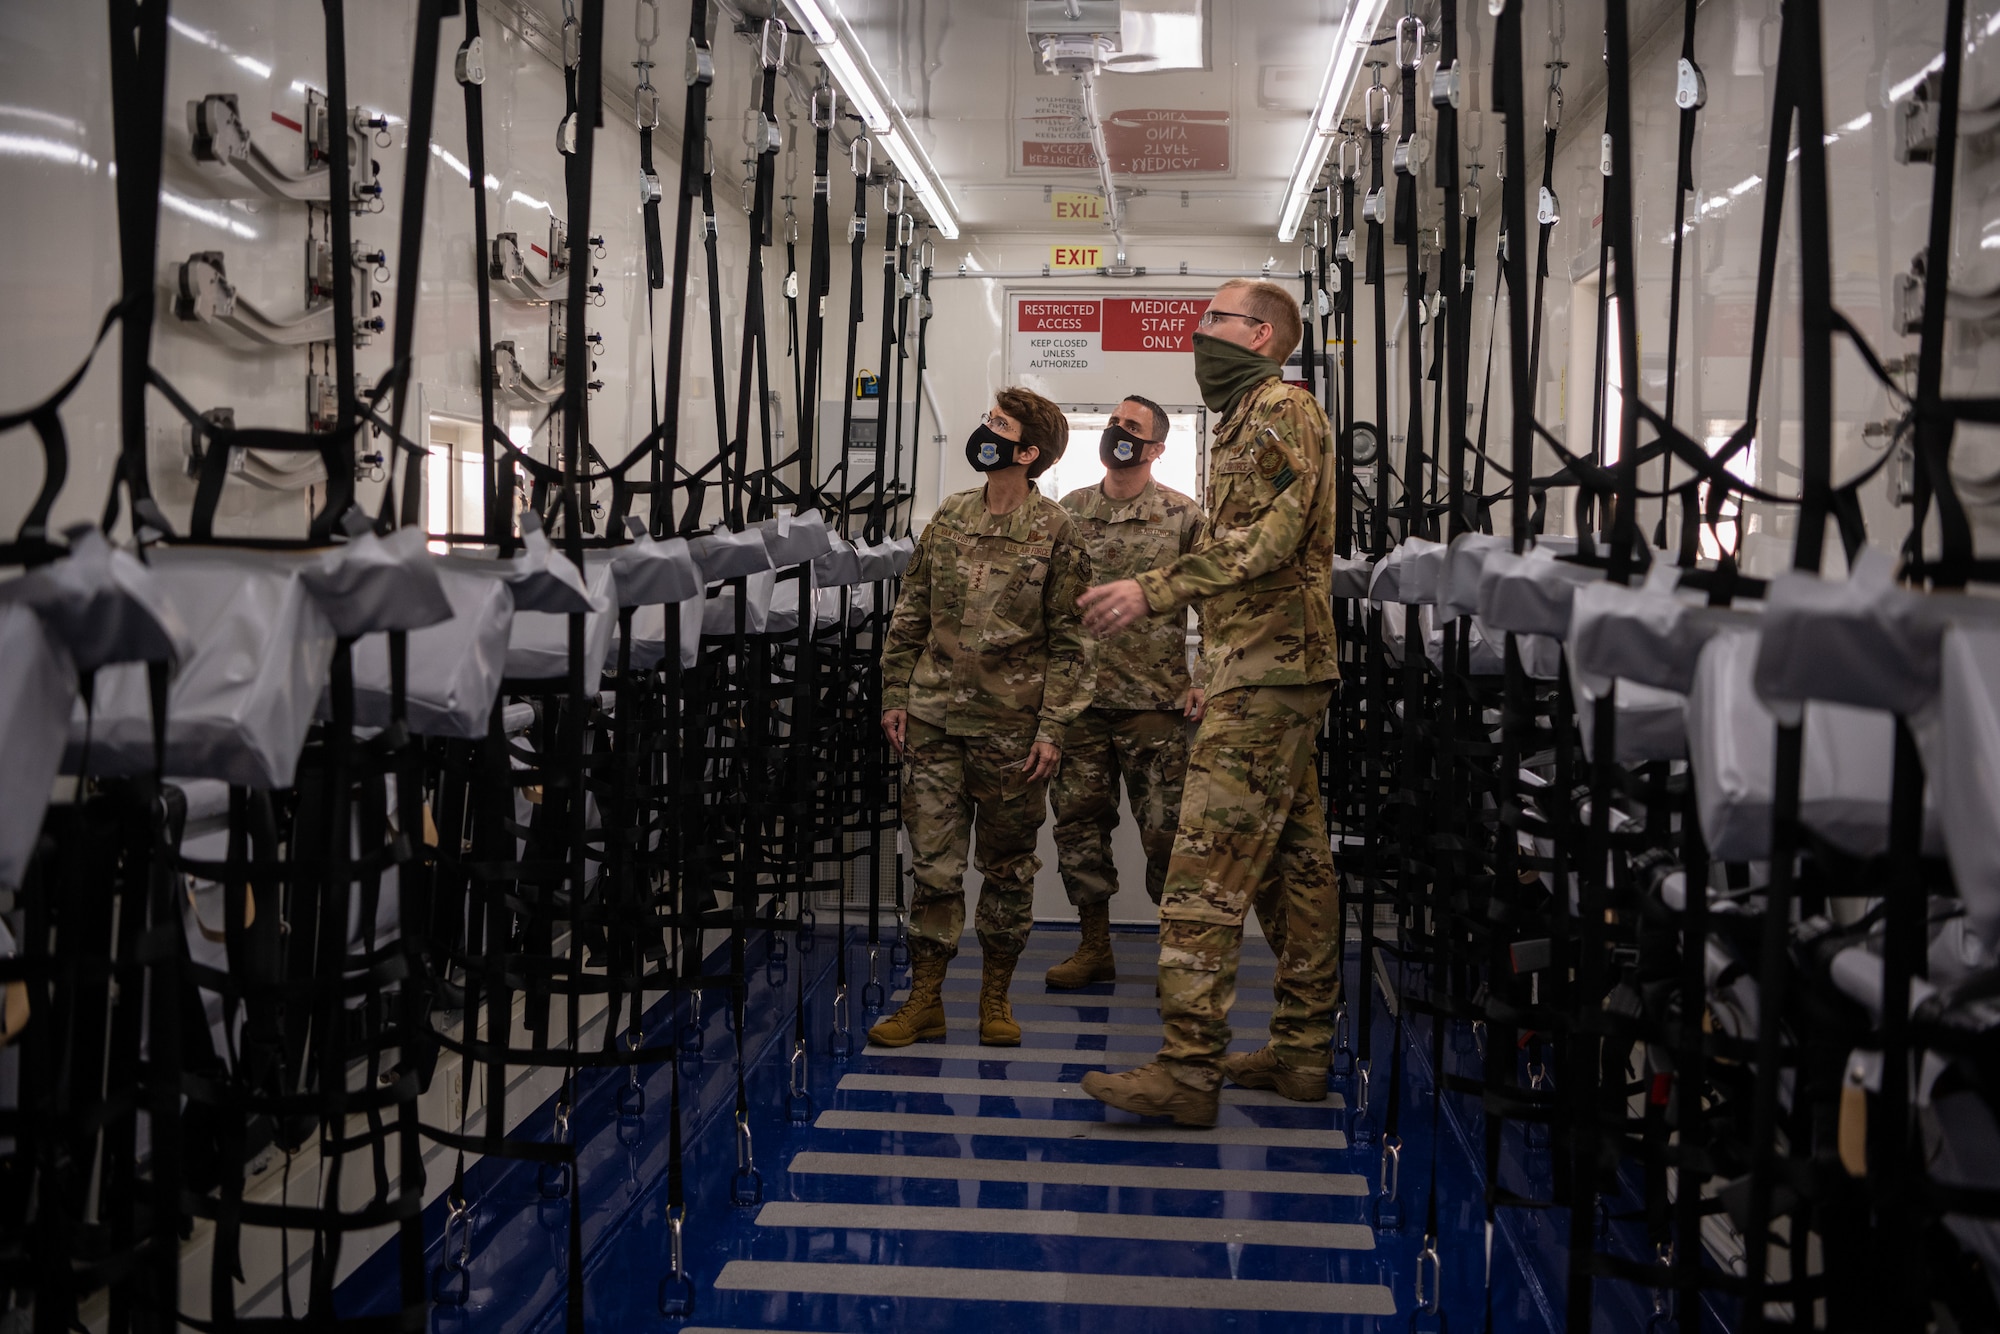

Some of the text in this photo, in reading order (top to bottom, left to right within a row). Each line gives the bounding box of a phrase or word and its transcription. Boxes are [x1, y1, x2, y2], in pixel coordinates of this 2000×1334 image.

[1056, 249, 1098, 265] EXIT
[1025, 304, 1095, 315] RESTRICTED
[1130, 301, 1198, 314] MEDICAL
[1037, 318, 1082, 329] ACCESS
[1141, 319, 1186, 331] STAFF
[1031, 339, 1088, 348] KEEP CLOSED
[1142, 335, 1184, 348] ONLY
[1043, 350, 1076, 358] UNLESS
[1030, 360, 1088, 368] AUTHORIZED
[1007, 543, 1049, 556] U.S. AIR FORCE
